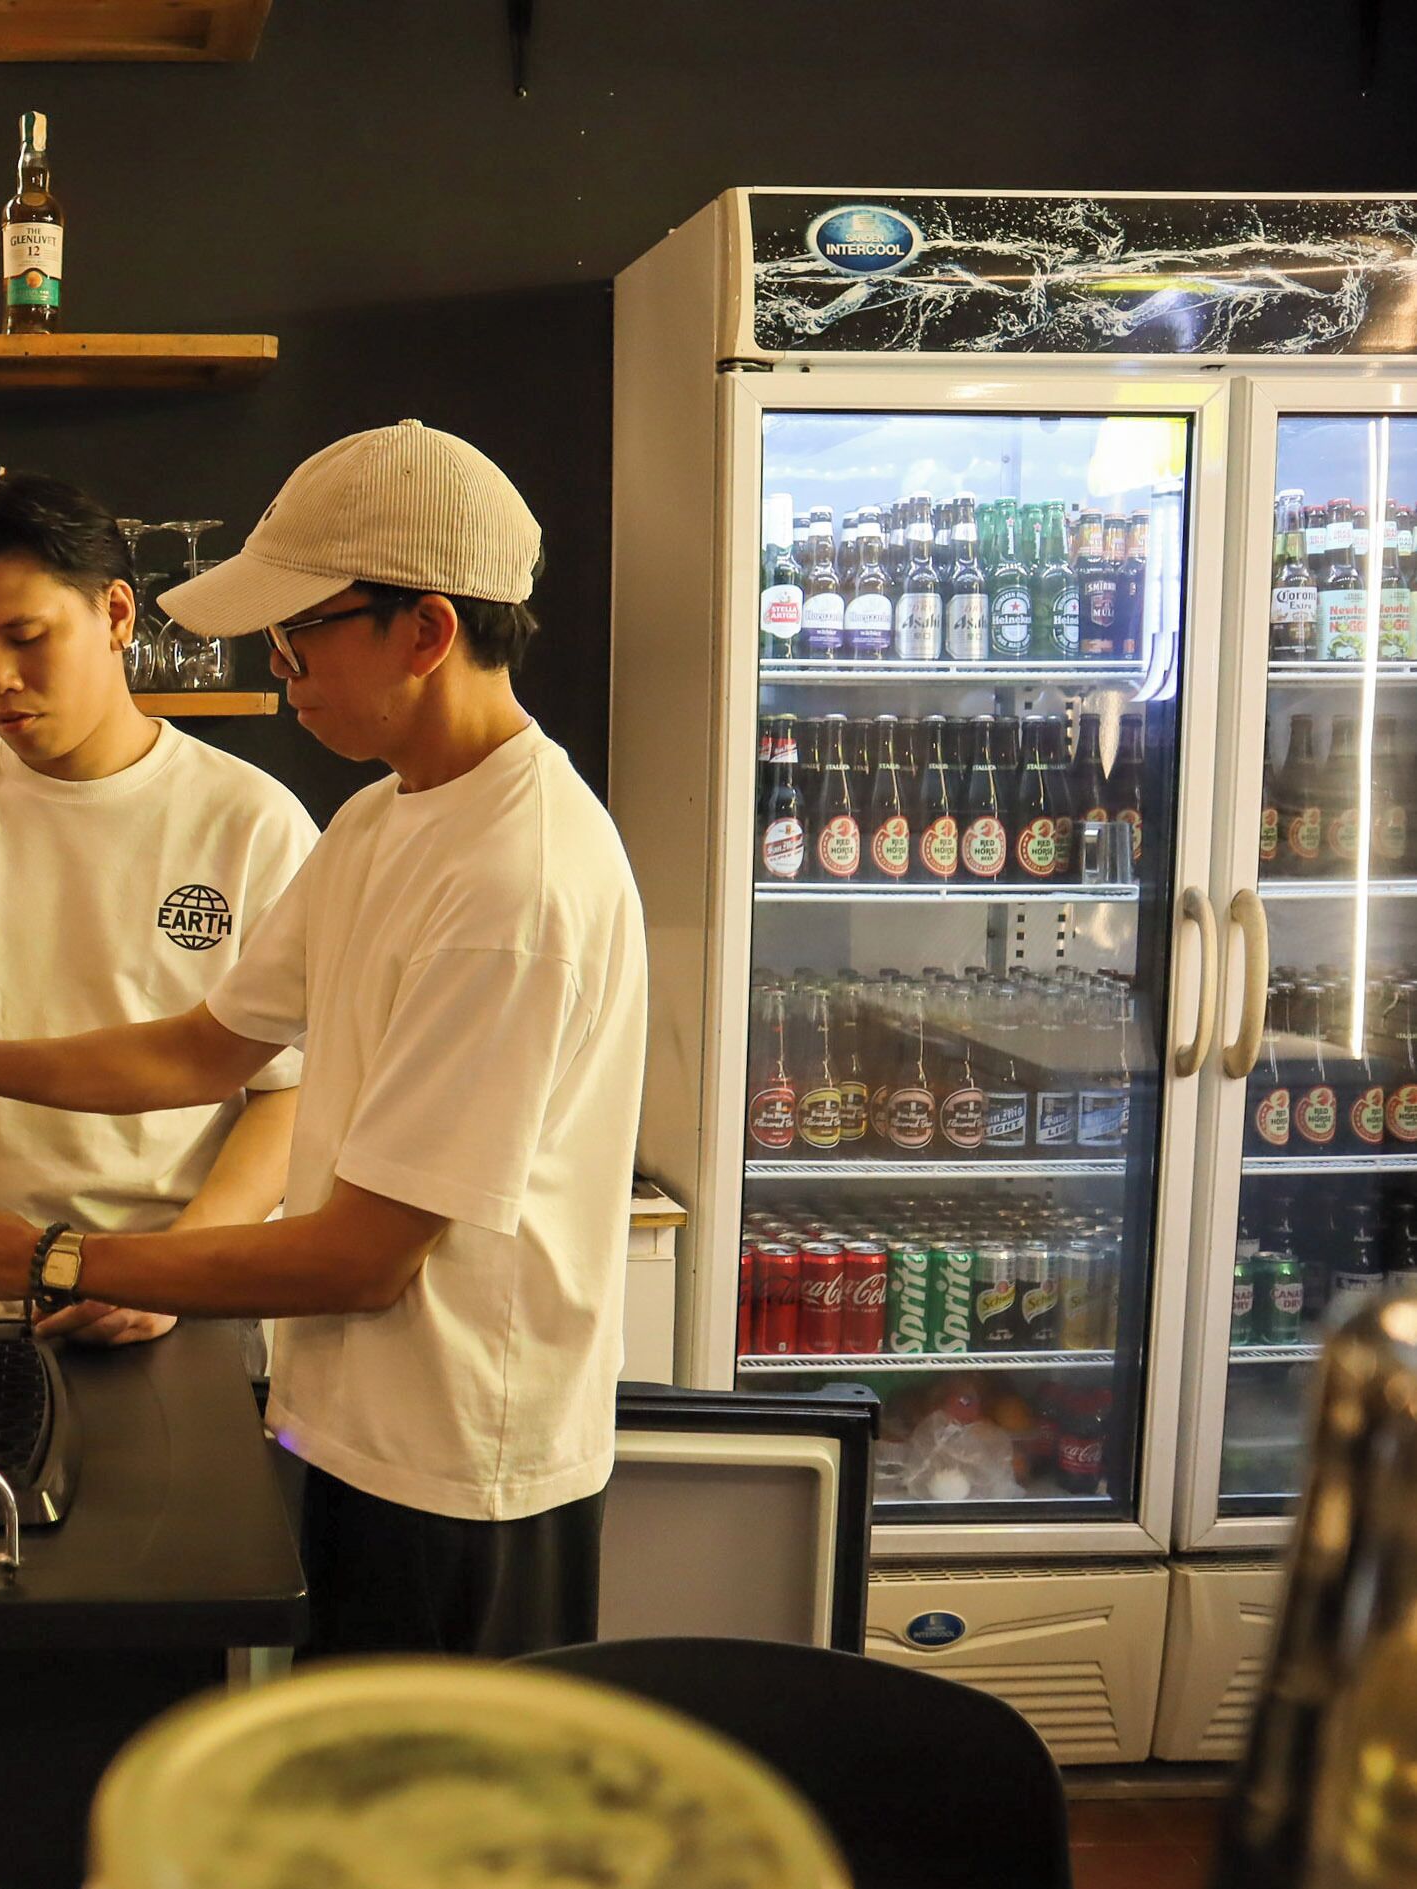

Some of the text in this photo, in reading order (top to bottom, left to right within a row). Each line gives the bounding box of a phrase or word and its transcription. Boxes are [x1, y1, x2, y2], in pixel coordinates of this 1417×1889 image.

[27, 227, 41, 235] THE
[10, 235, 56, 247] GLENLIVET
[28, 246, 40, 257] 12
[825, 244, 905, 256] INTERCOOL
[902, 613, 940, 629] Asahi
[980, 839, 995, 847] RED
[157, 906, 232, 935] EARTH
[890, 1253, 928, 1354] Sprite
[934, 1253, 972, 1353] Sprite
